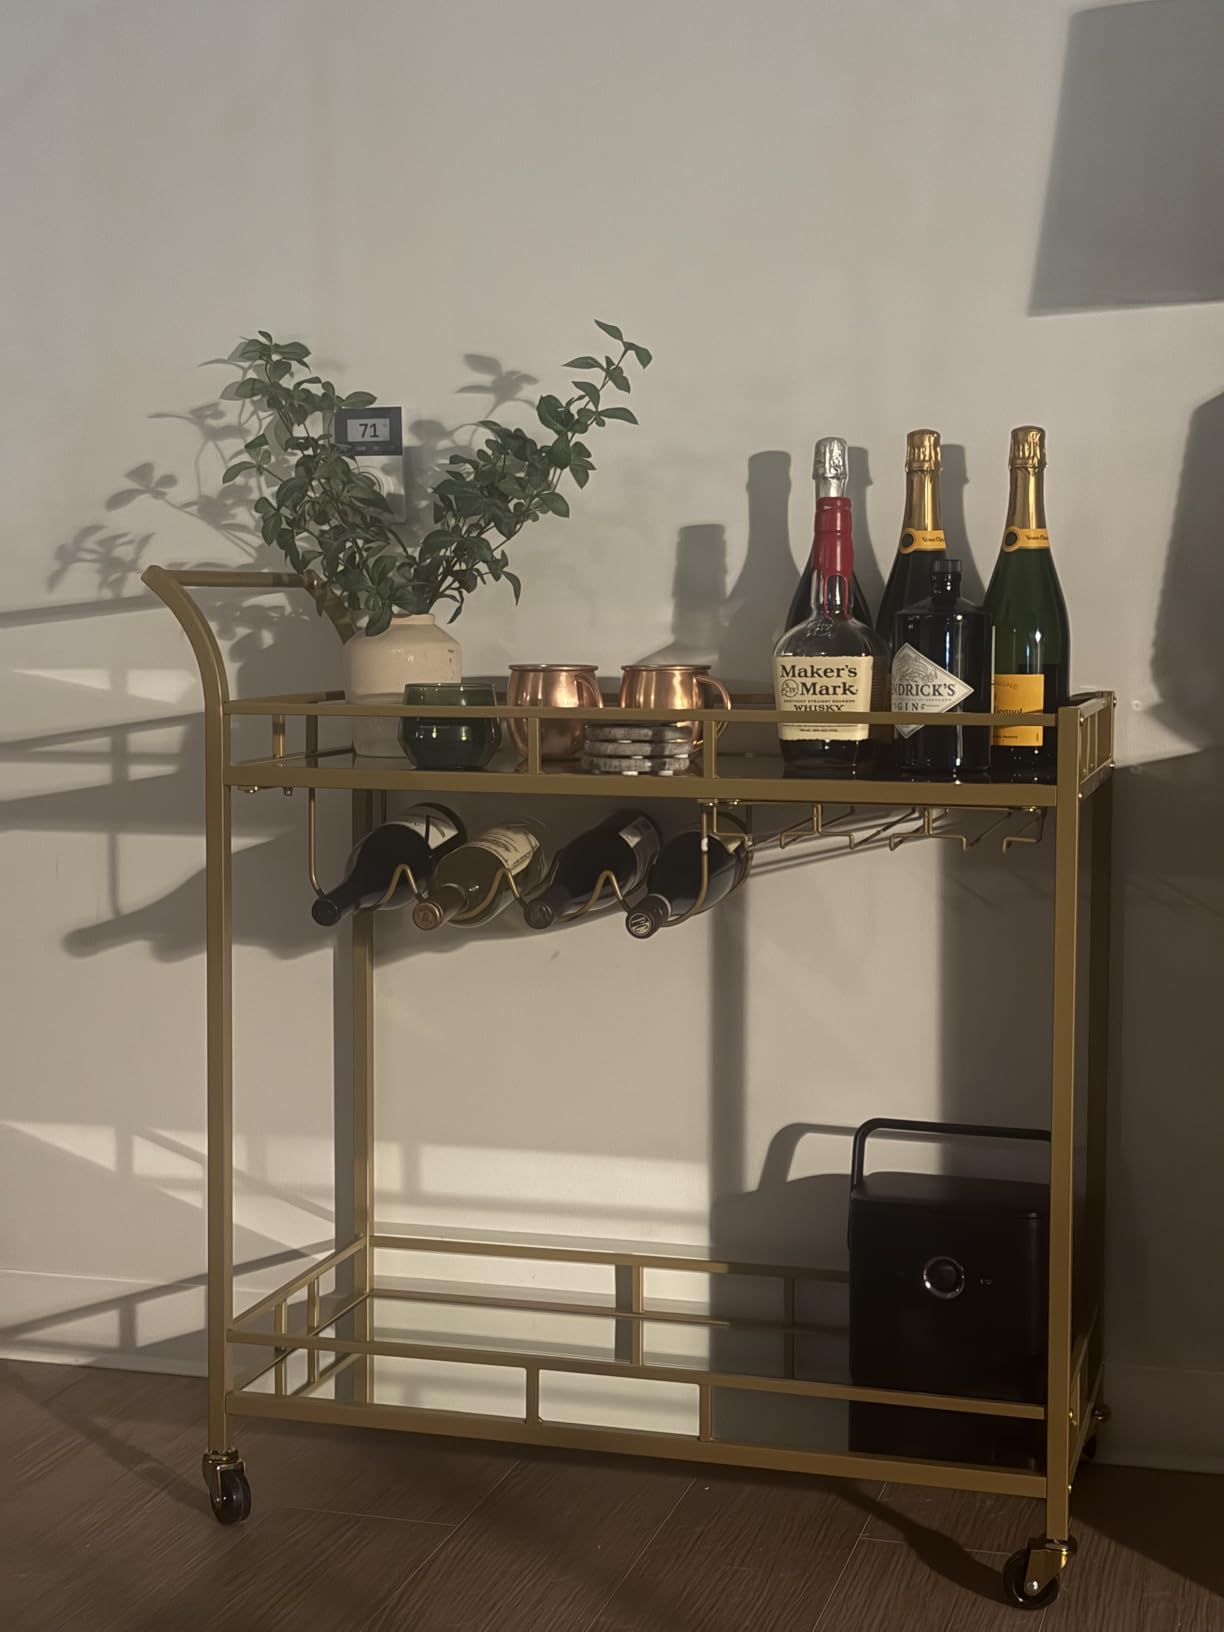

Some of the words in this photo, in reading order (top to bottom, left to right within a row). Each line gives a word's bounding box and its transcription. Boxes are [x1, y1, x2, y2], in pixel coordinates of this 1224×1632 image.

[358, 422, 380, 439] 71
[779, 664, 858, 679] Maker's
[800, 681, 859, 696] Mark
[891, 683, 956, 697] NDRICK'S
[793, 704, 845, 712] WHISKY
[897, 702, 919, 711] GIN
